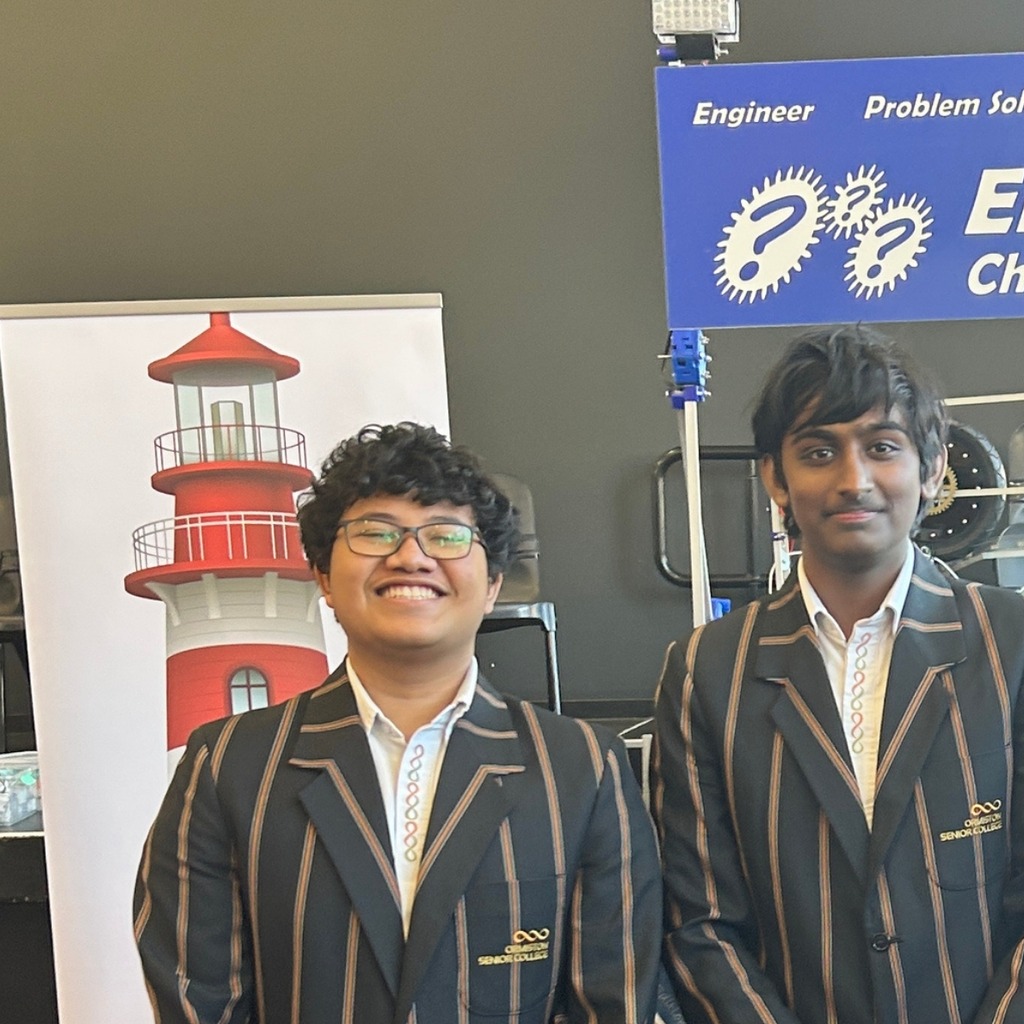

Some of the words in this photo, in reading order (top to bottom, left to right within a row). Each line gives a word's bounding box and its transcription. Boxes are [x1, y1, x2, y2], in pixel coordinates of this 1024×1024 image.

[692, 100, 815, 128] Engineer
[863, 93, 980, 120] Problem
[940, 828, 973, 842] SENIOR
[973, 821, 1003, 835] COLLEGE
